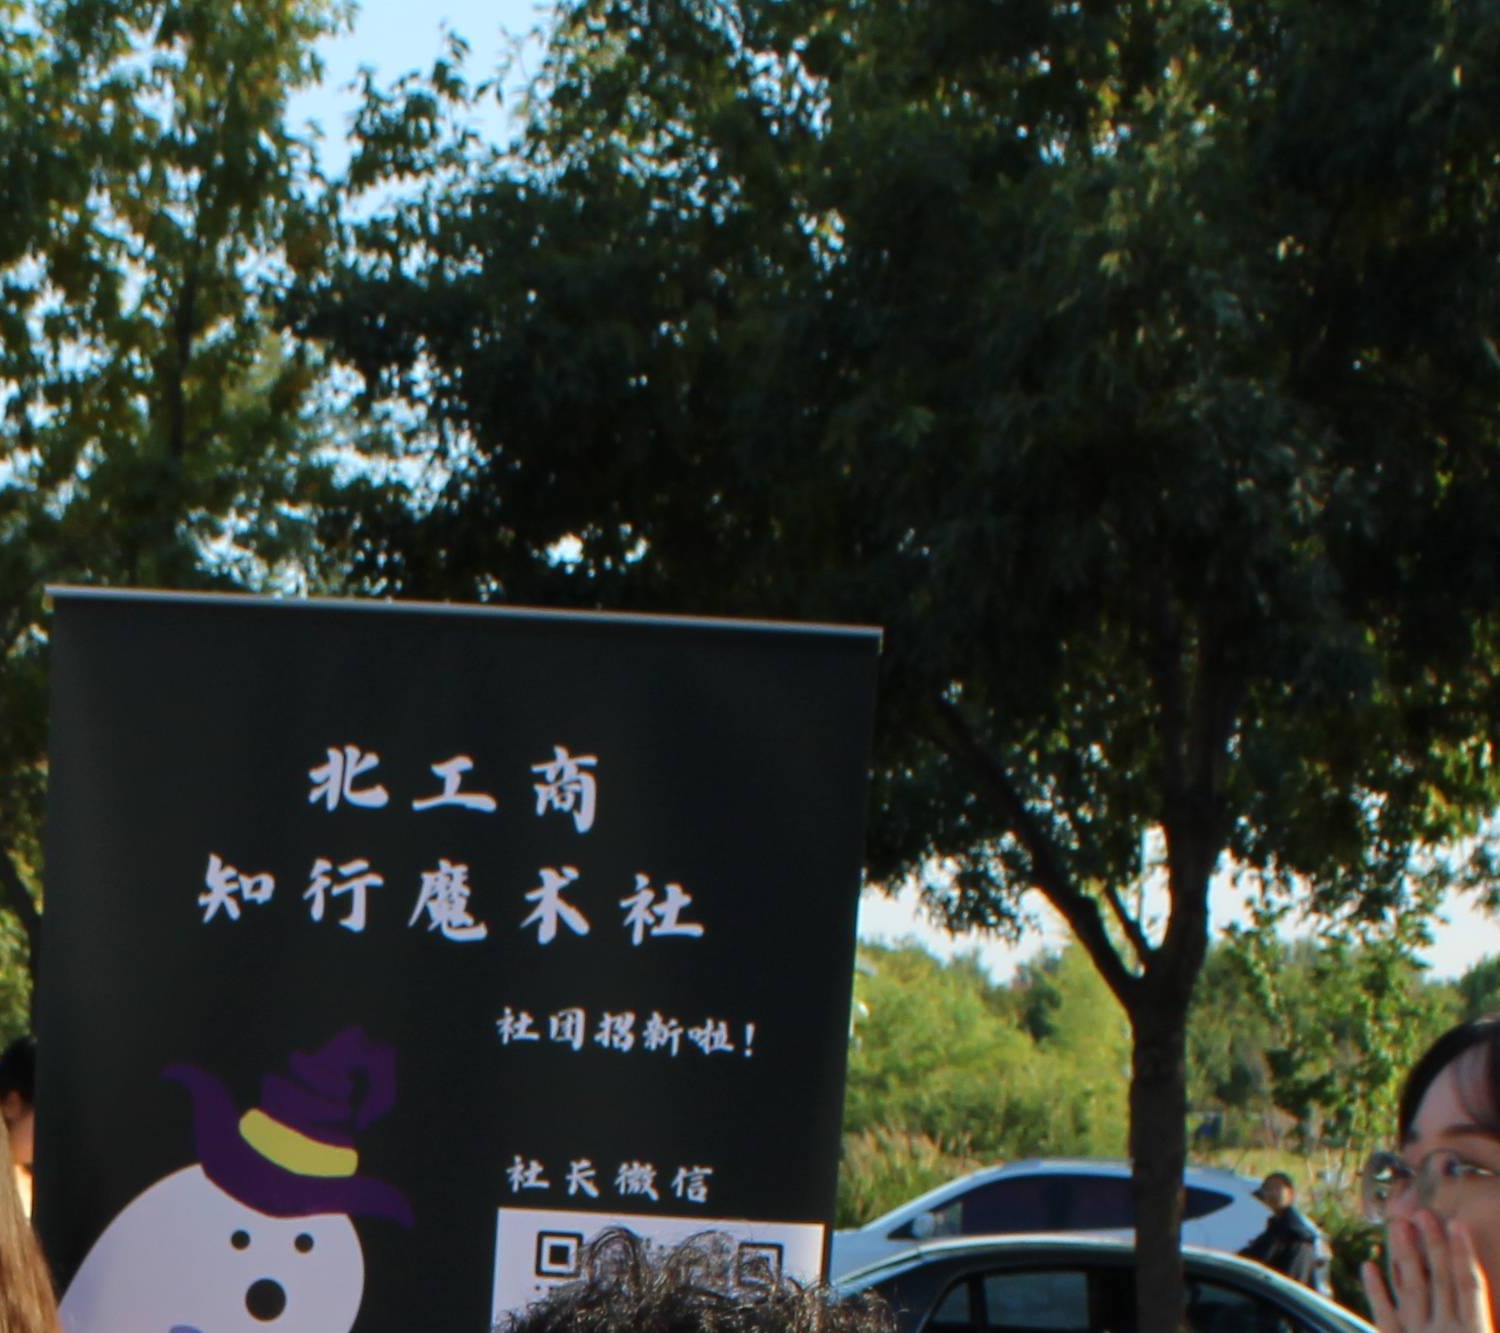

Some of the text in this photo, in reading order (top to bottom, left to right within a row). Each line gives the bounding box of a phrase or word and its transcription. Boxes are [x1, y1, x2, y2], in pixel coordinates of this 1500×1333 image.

[308, 745, 601, 833] 北工商
[198, 855, 705, 946] 知行魔术社
[505, 1156, 714, 1204] 社长微信
